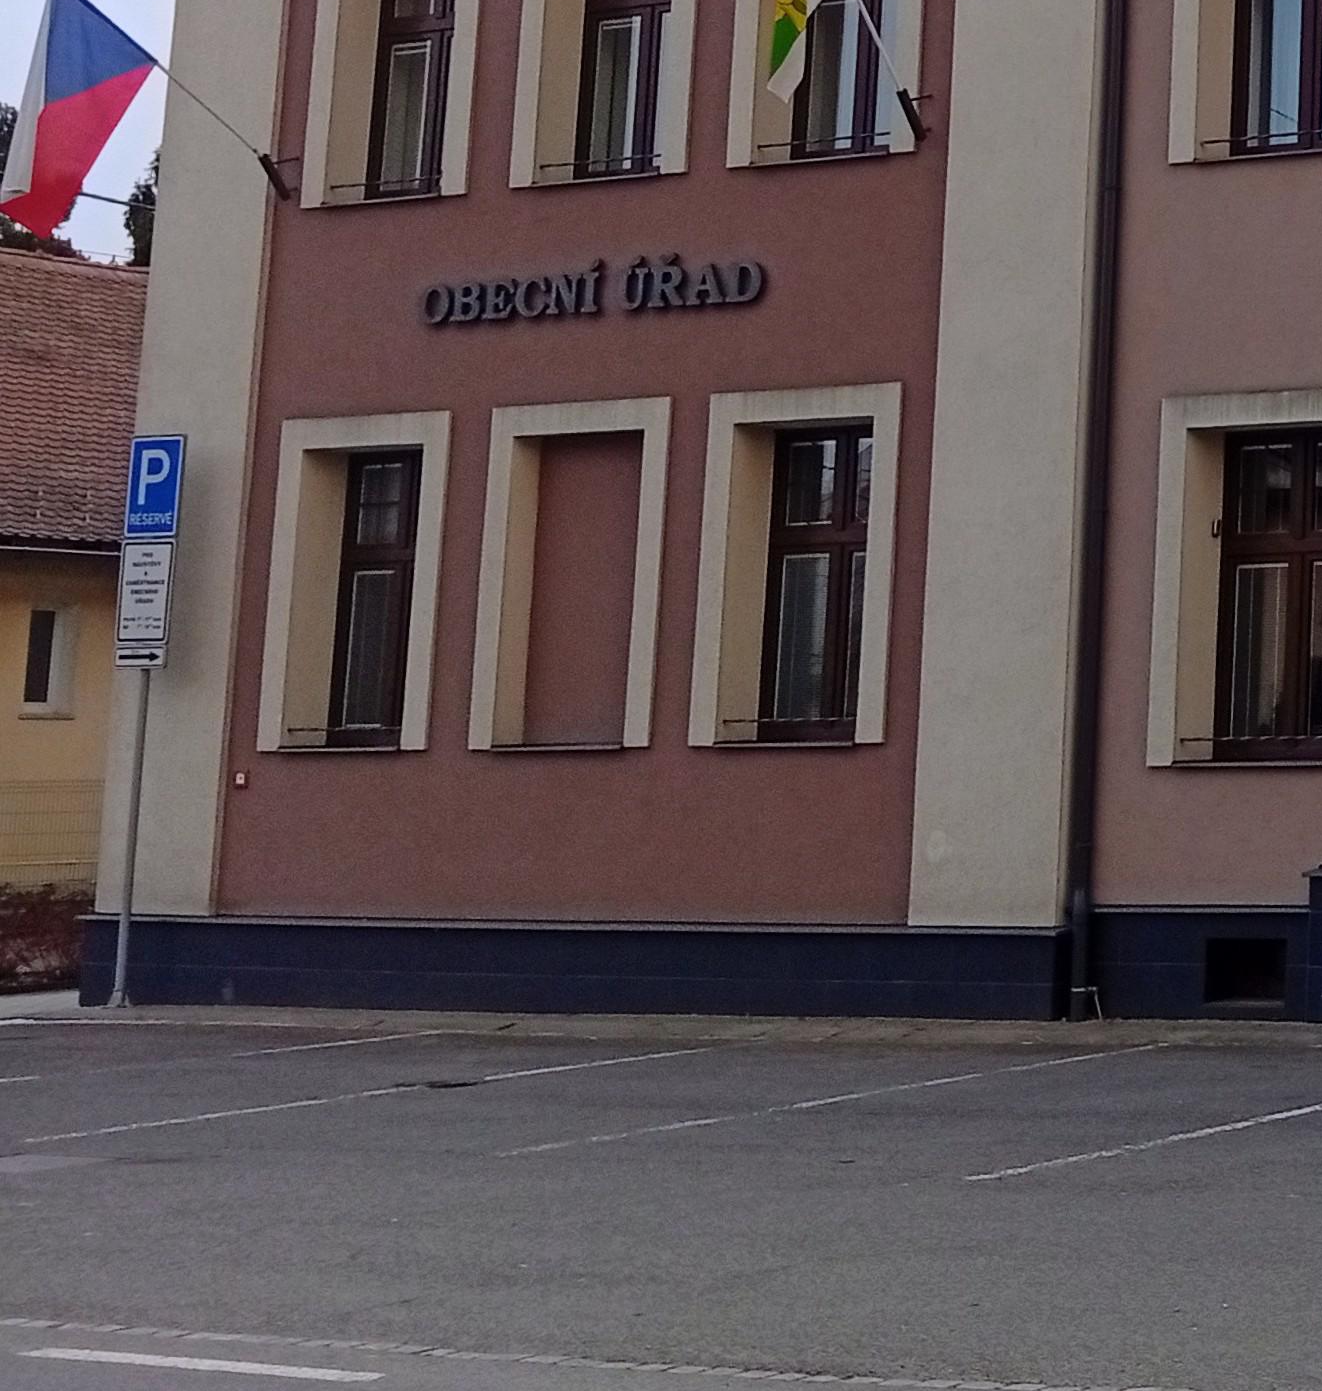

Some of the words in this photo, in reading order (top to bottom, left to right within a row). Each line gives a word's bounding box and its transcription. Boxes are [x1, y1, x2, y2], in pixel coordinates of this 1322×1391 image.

[423, 258, 604, 324] OBECNÍ
[624, 252, 766, 309] ÚŘAD
[137, 449, 170, 505] P
